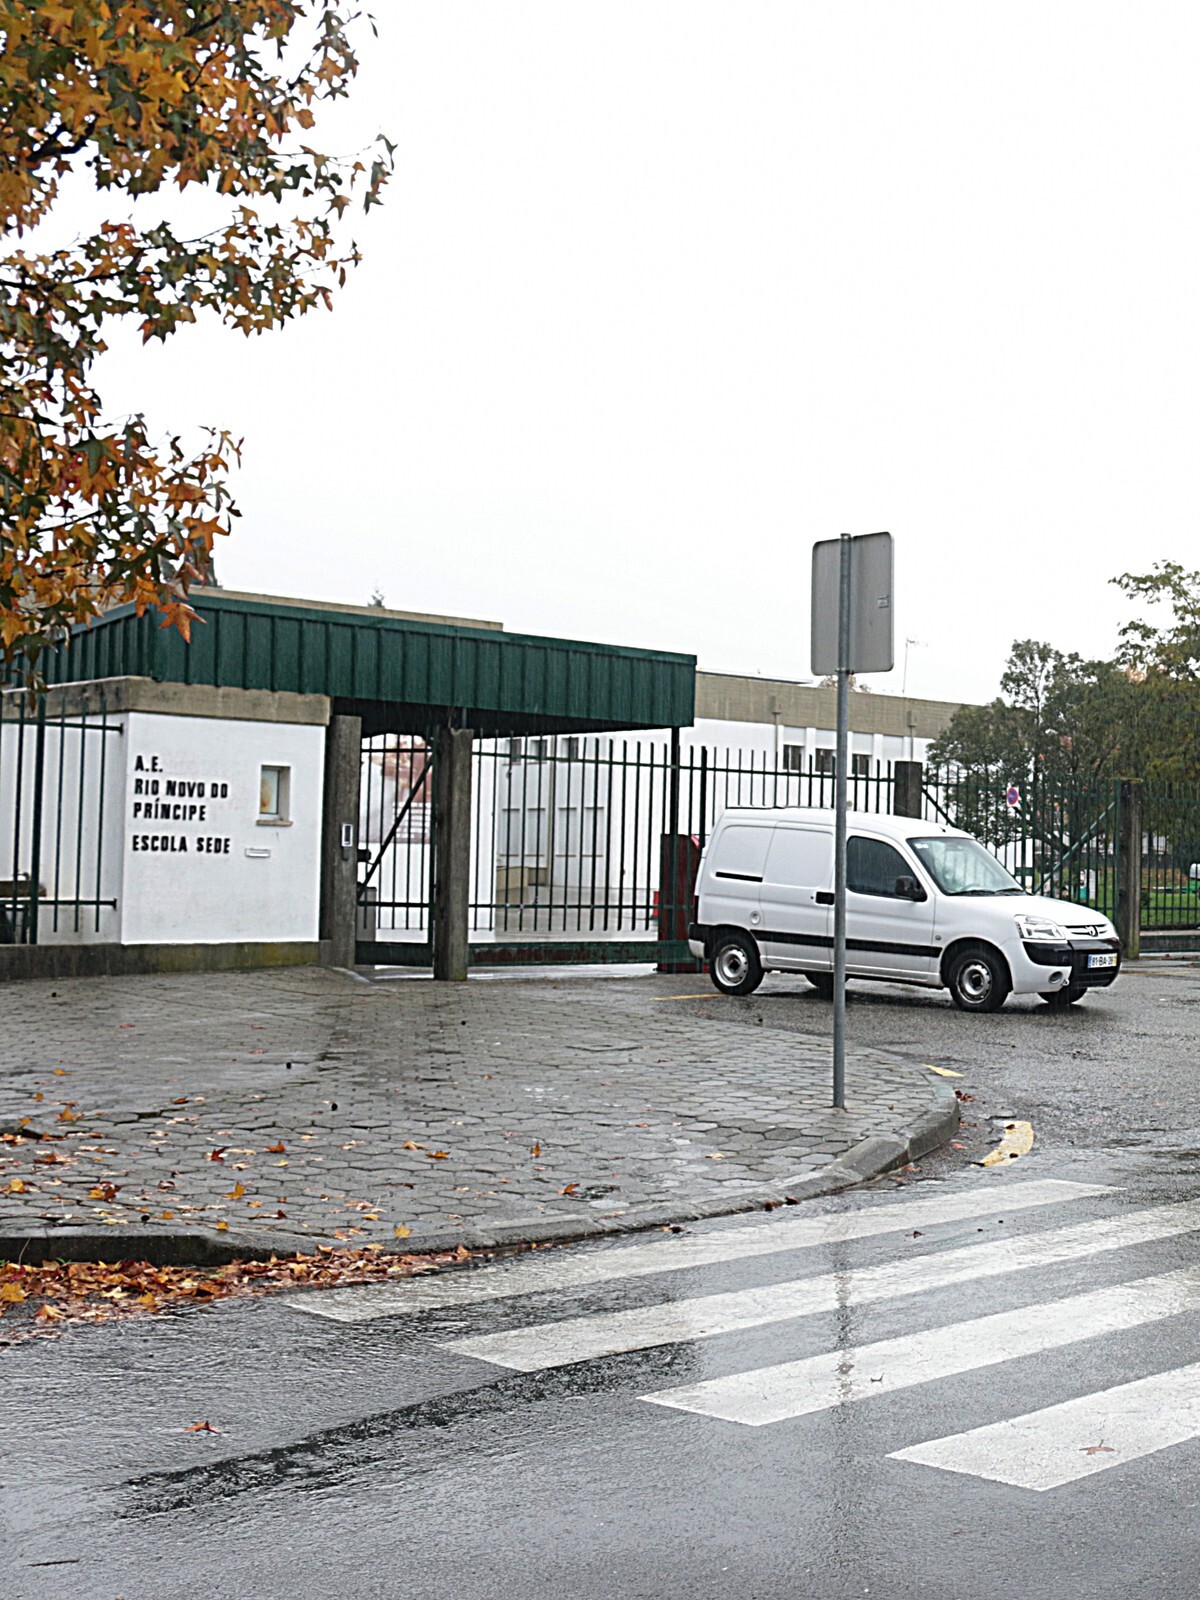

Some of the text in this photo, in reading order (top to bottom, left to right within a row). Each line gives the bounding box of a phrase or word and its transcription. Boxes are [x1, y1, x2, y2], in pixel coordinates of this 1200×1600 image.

[134, 754, 163, 773] A.E.
[134, 778, 229, 799] RIO NOVO DO
[132, 797, 207, 822] PRÍNCIPE
[132, 834, 231, 855] ESCOLA SEDE
